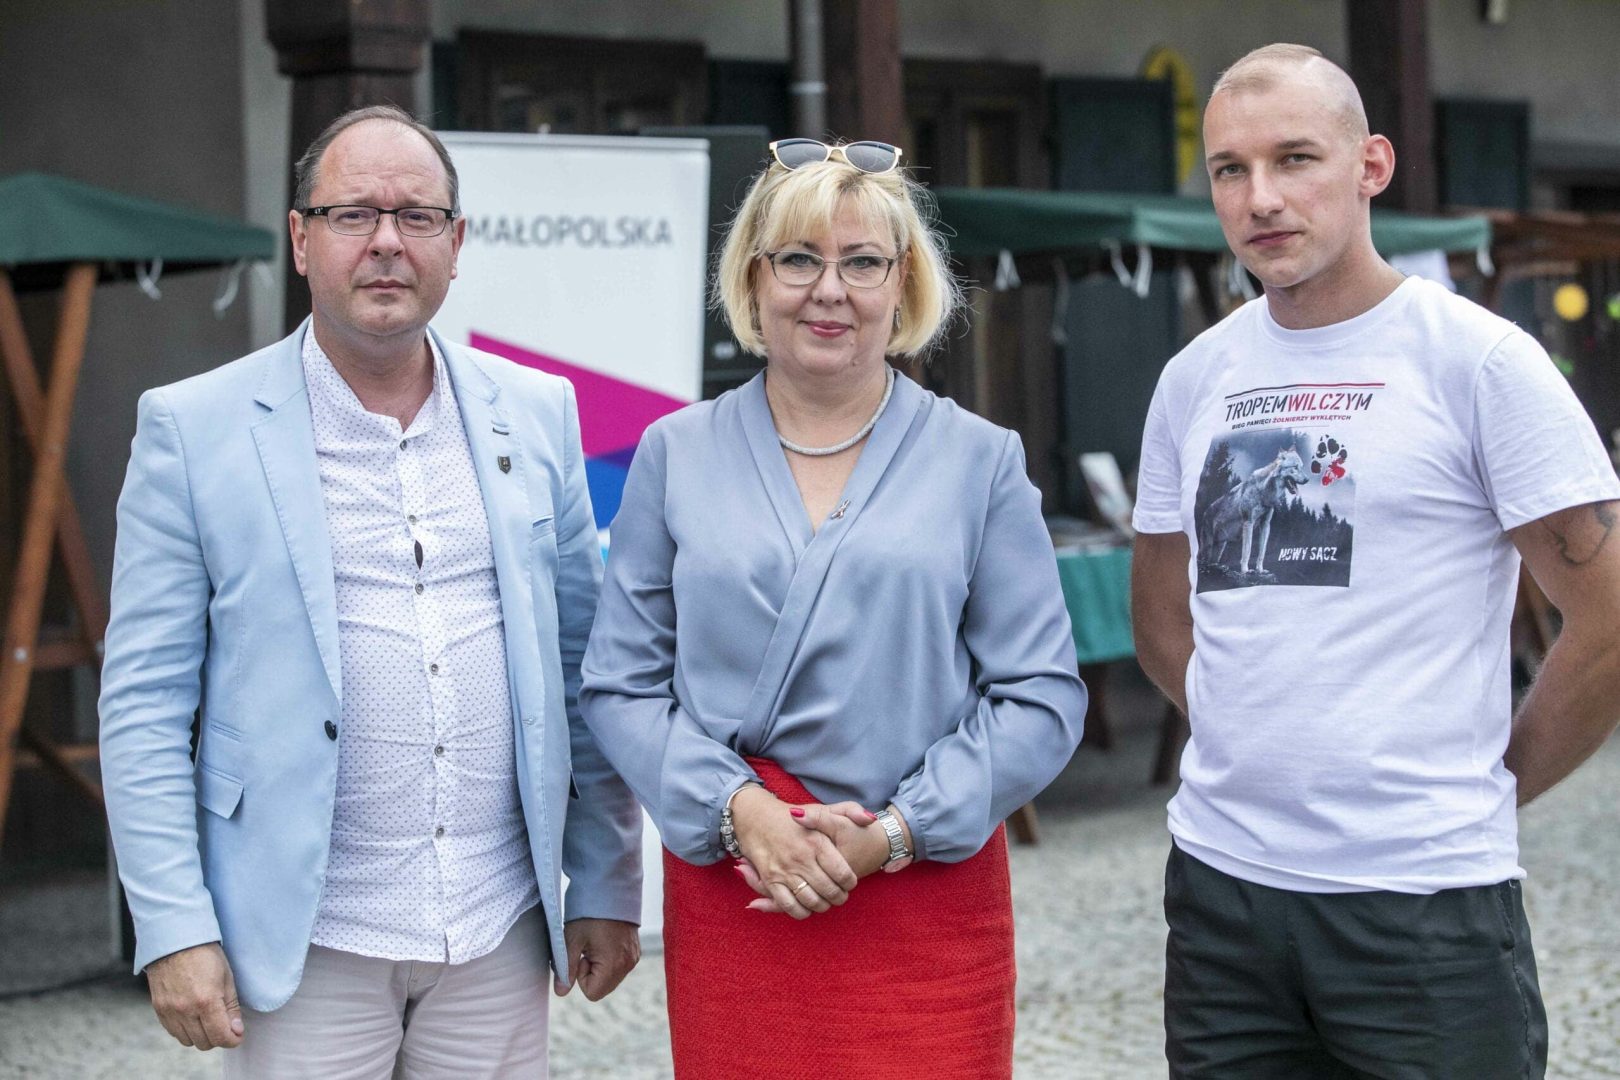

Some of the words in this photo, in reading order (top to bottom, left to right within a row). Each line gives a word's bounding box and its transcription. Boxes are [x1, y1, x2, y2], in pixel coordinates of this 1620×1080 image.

[466, 214, 673, 247] MAŁOPOLSKA
[1231, 422, 1246, 430] BIEG
[1278, 547, 1309, 561] NOWY
[1309, 546, 1338, 563] SĄCZ
